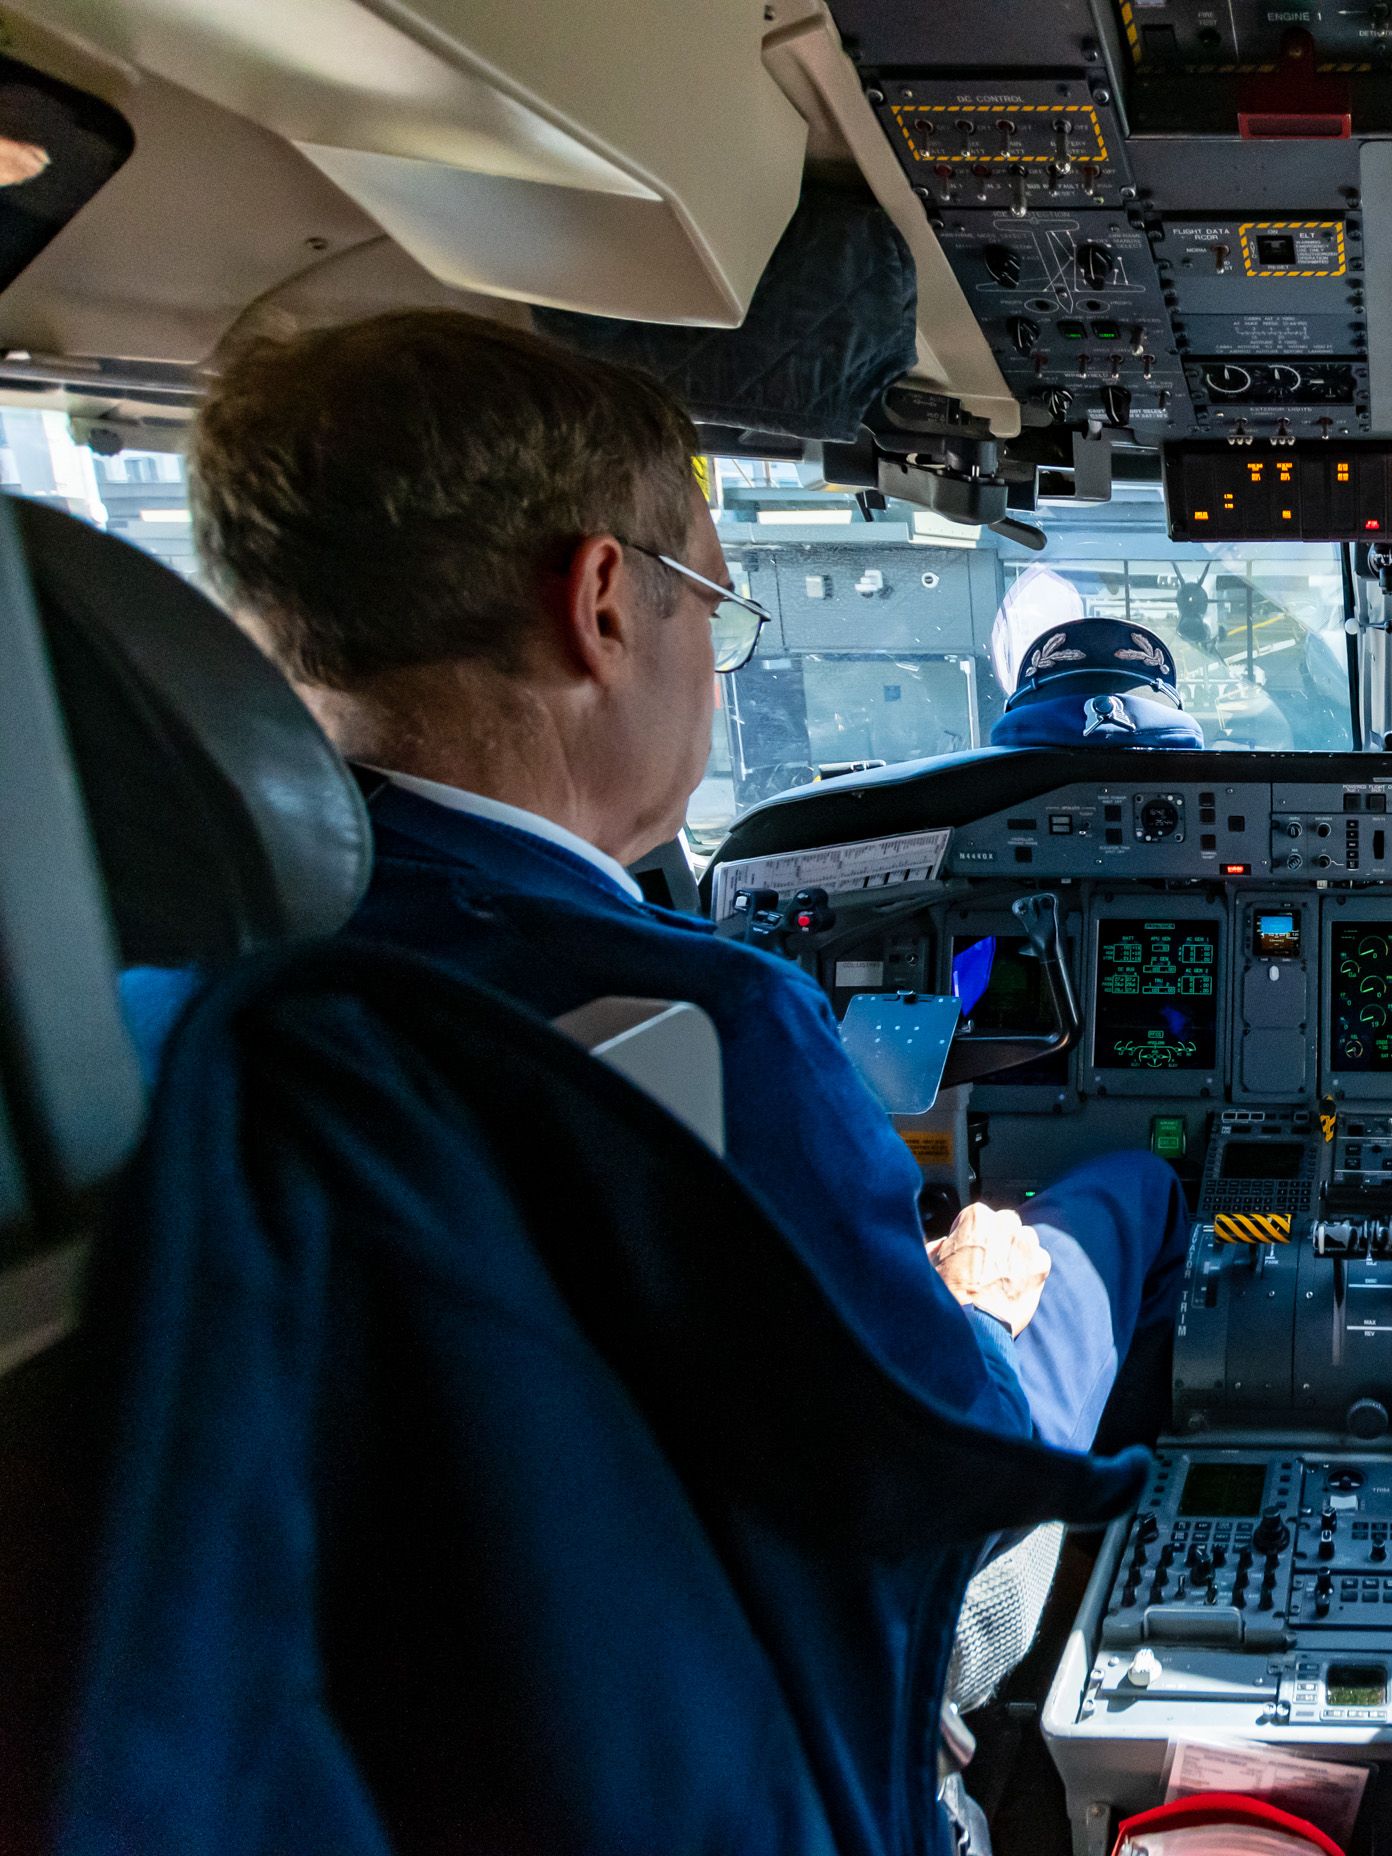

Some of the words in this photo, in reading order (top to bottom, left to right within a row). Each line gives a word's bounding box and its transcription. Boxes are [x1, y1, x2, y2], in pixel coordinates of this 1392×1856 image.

[1267, 12, 1311, 21] ENGINE
[976, 95, 1025, 103] CONTROL
[1318, 1225, 1325, 1255] 1
[1177, 1290, 1189, 1337] TRIM
